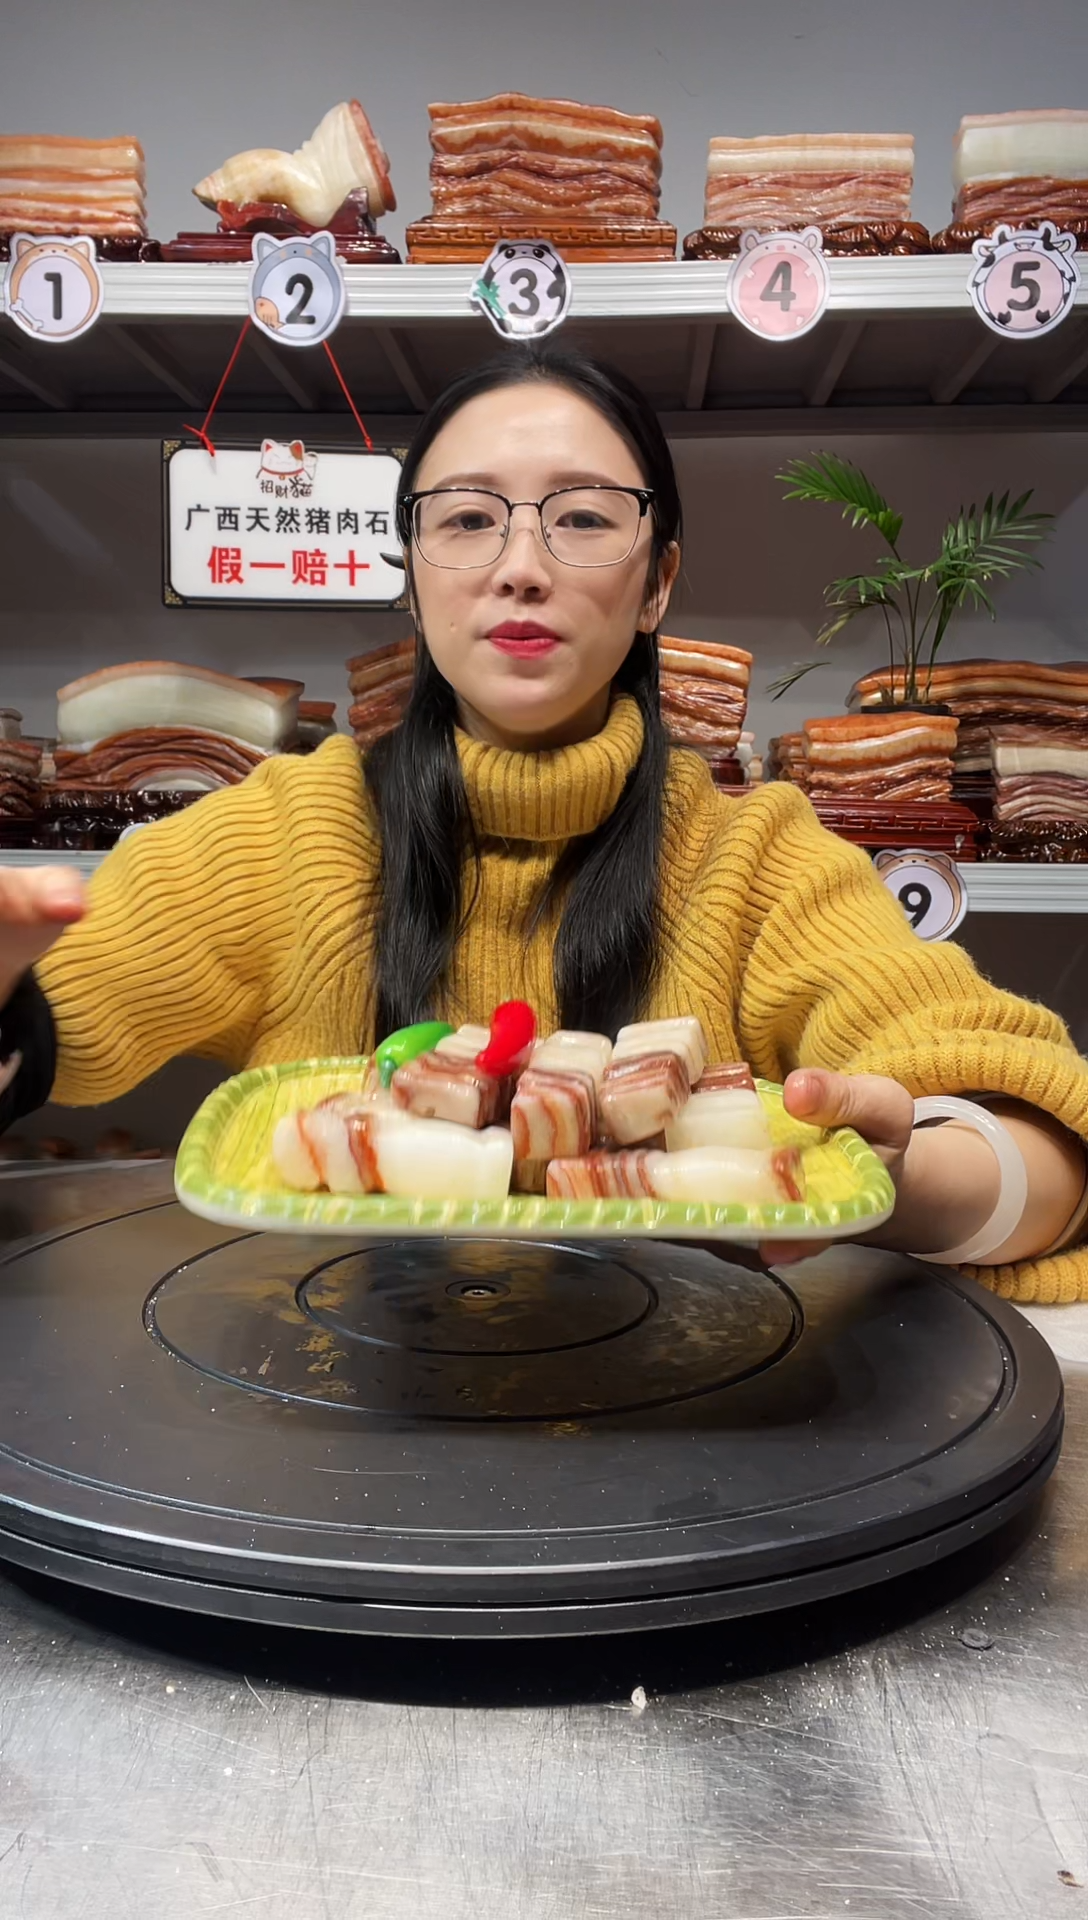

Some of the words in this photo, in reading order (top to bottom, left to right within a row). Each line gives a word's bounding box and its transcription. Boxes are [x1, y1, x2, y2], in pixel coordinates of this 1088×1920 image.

[44, 272, 62, 320] 1
[284, 273, 316, 325] 2
[508, 269, 541, 317] 3
[759, 261, 797, 312] 4
[1008, 260, 1042, 312] 5
[260, 475, 313, 499] 招财猫
[184, 504, 390, 536] 广西天然猪肉石
[207, 546, 371, 587] 假一赔十
[898, 882, 932, 929] 9
